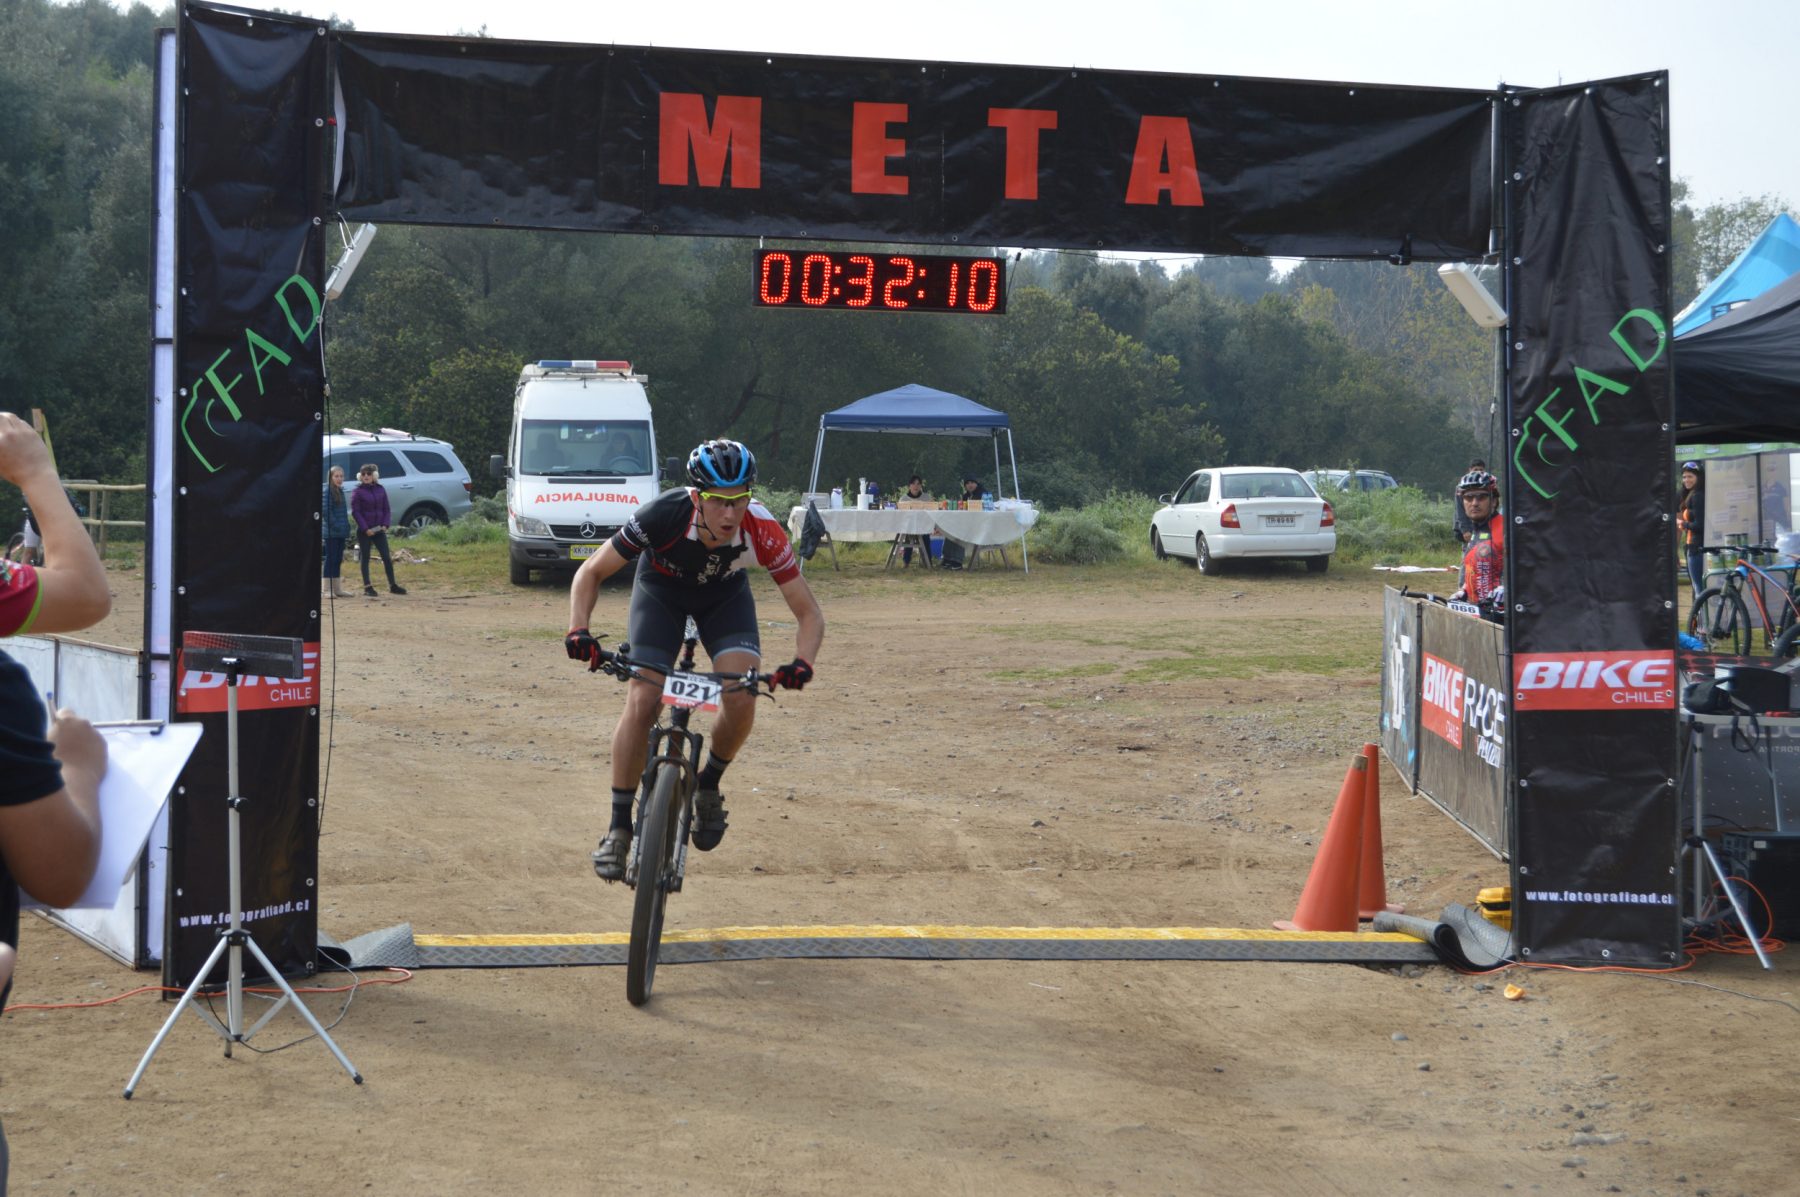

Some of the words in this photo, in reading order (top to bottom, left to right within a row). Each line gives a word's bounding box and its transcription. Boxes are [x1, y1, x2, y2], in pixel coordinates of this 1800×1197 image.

[658, 91, 1204, 206] META
[760, 253, 998, 312] 00:32:10
[1517, 659, 1671, 689] BIKE
[270, 687, 312, 701] CHILE
[670, 680, 711, 701] 021
[1423, 657, 1464, 718] BIKE
[1463, 676, 1506, 744] RACE
[1611, 691, 1665, 704] CHILE
[1525, 891, 1672, 905] www.fotografiaad.cl
[179, 899, 309, 927] www.foografiaad.cl
